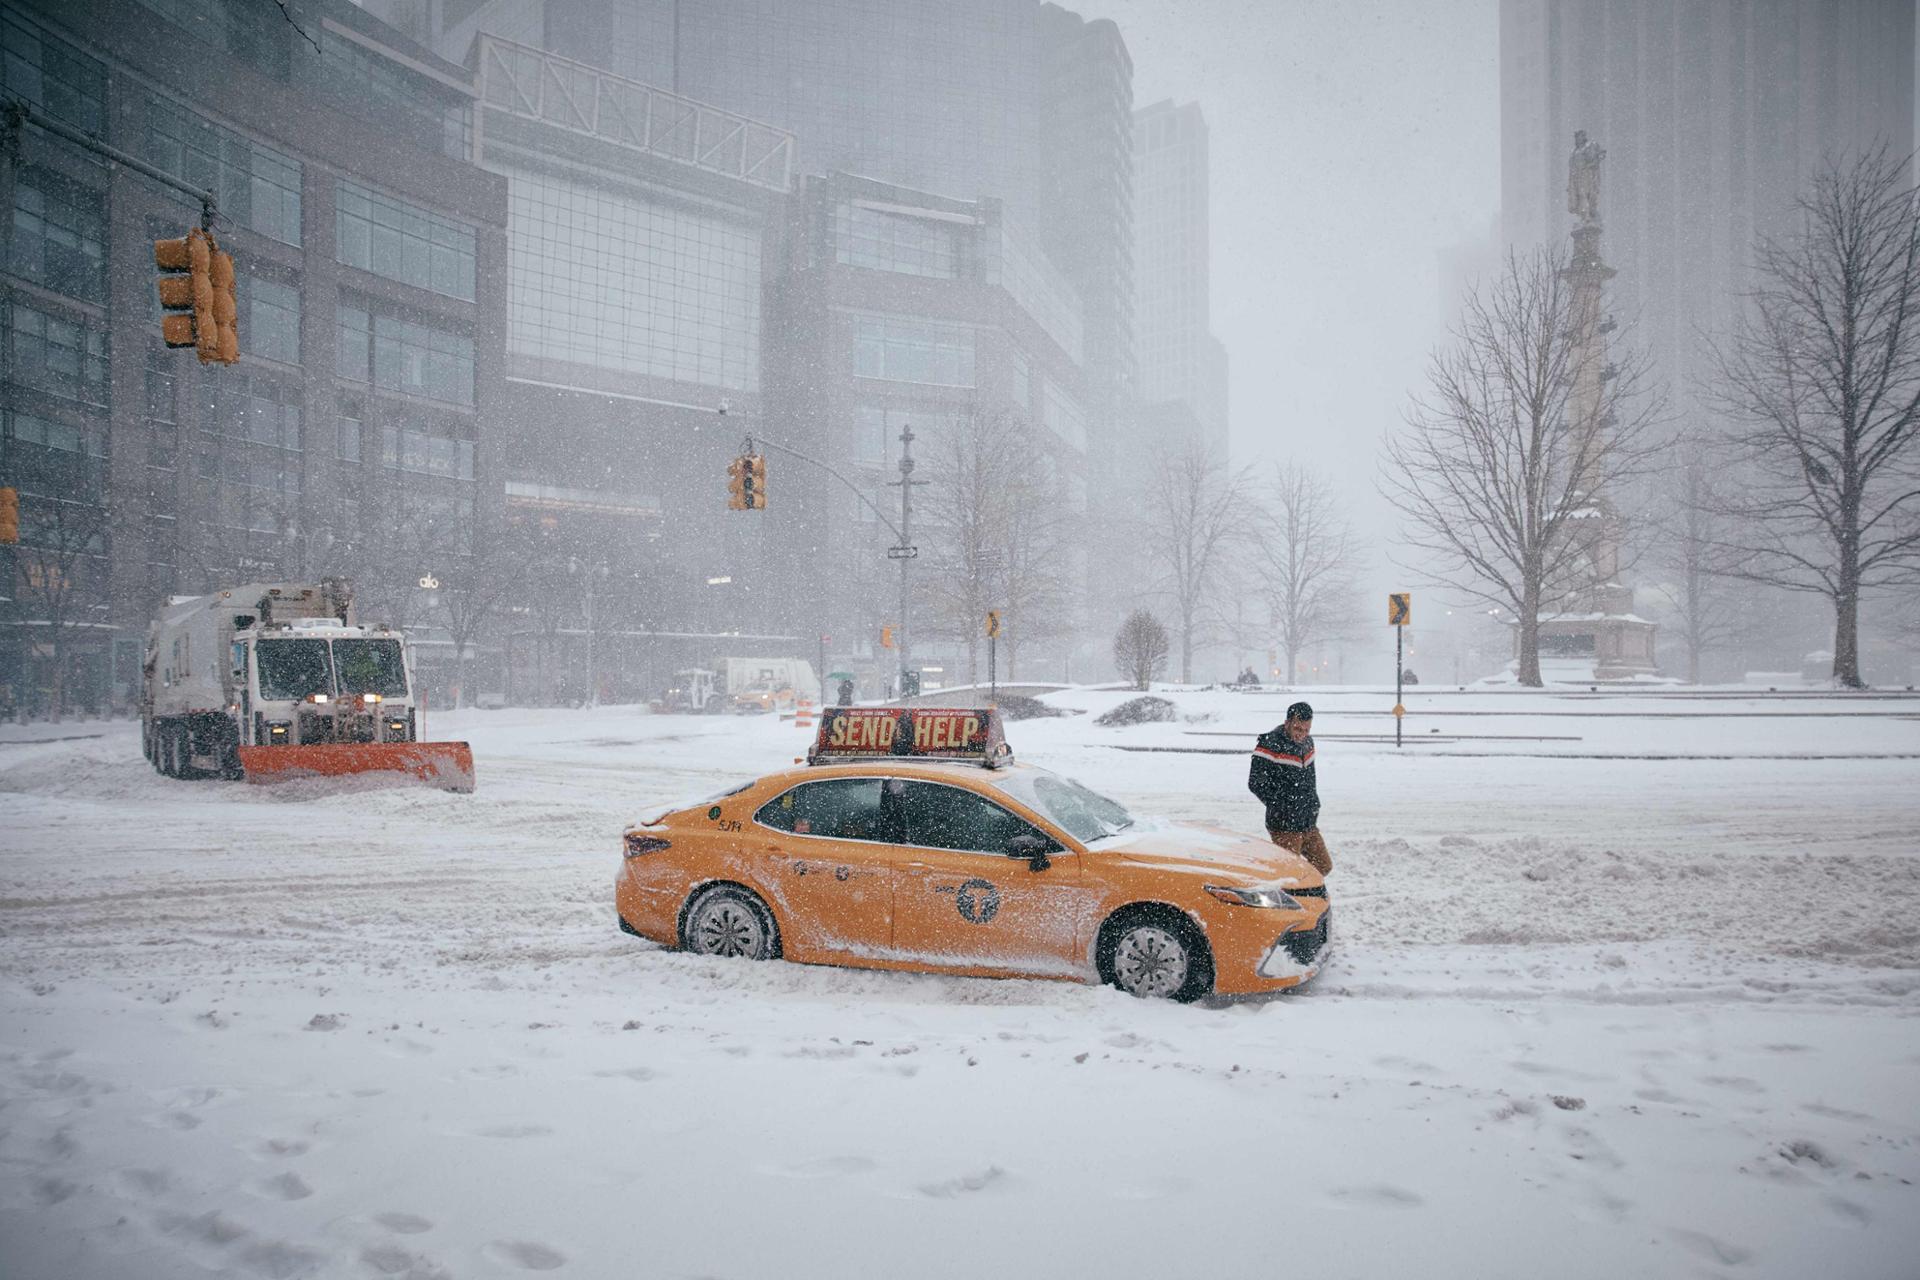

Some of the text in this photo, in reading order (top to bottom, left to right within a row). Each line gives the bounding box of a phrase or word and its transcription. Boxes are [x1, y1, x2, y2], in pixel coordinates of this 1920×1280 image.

[420, 572, 439, 588] alo
[830, 716, 979, 748] SEND HELP
